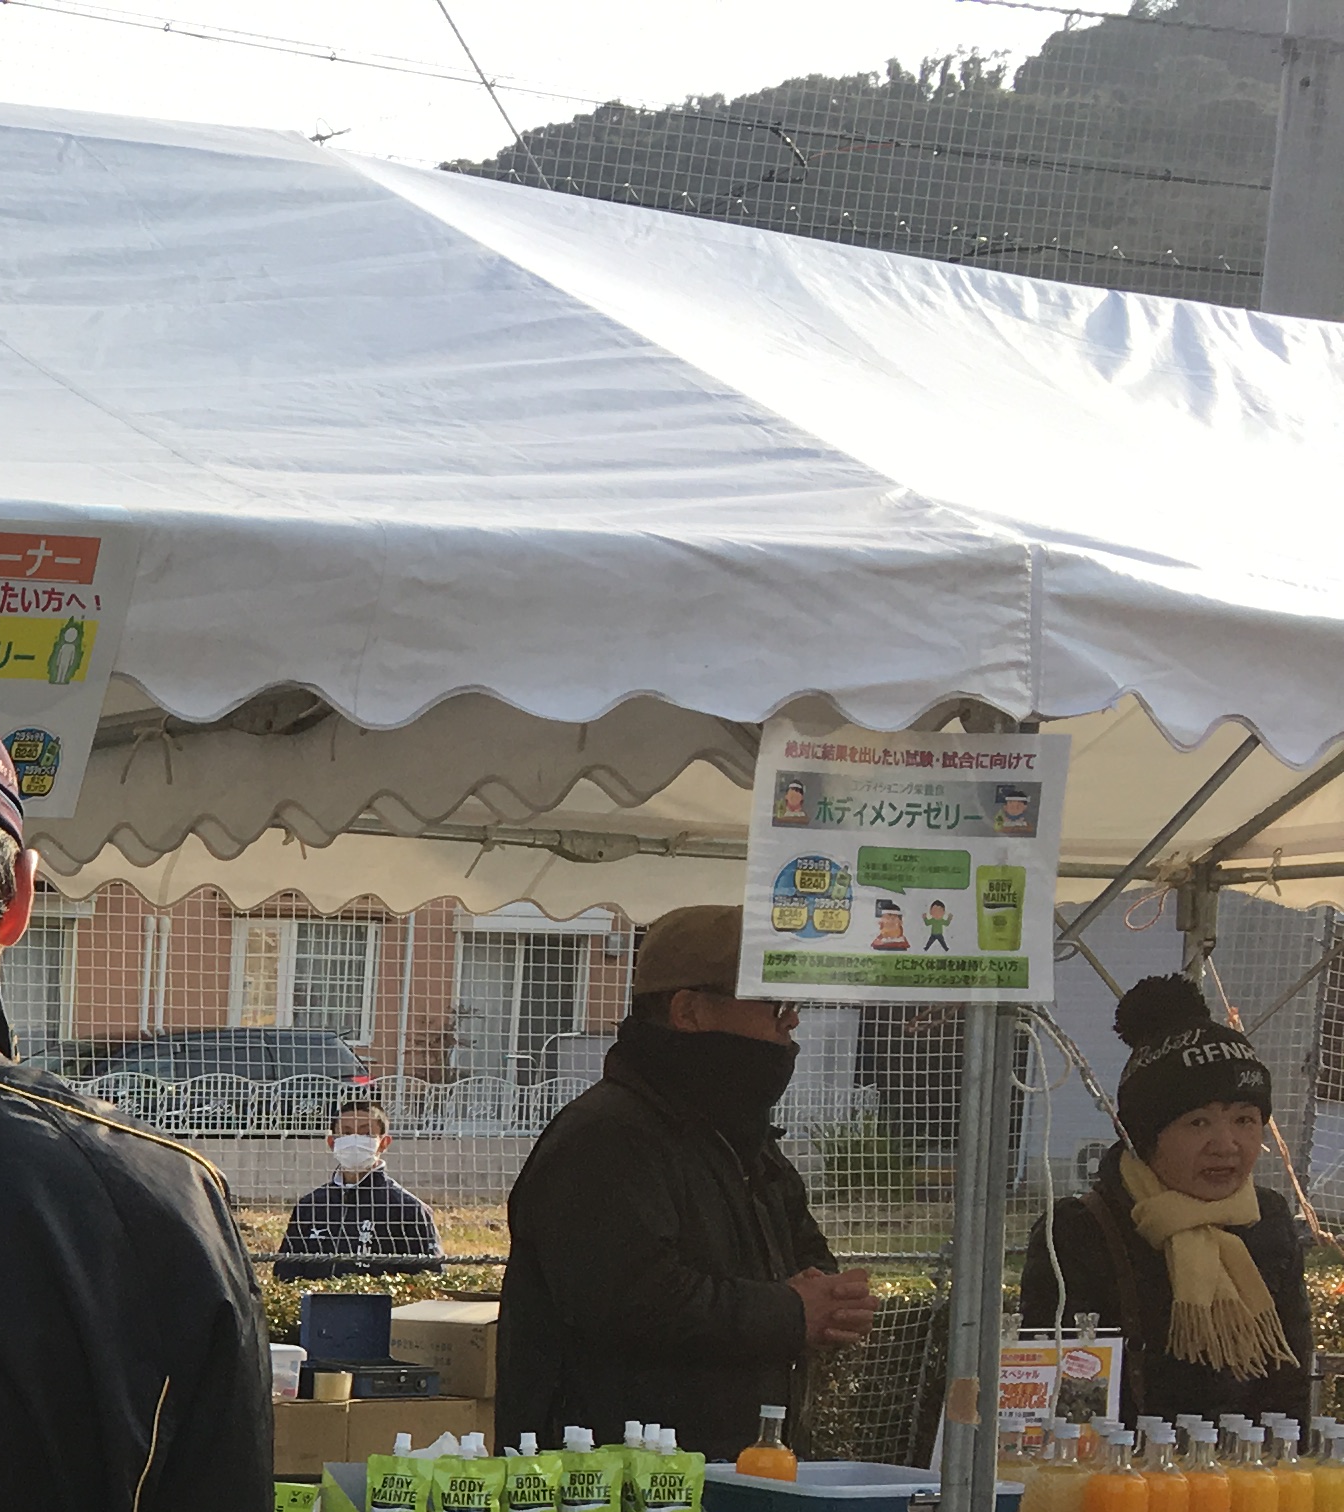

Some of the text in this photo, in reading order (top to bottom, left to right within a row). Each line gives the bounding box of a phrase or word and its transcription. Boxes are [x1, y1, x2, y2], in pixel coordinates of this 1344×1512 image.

[814, 797, 984, 830] ボディメンテゼリー
[381, 1476, 413, 1490] BODY
[449, 1479, 486, 1493] BODY
[515, 1477, 547, 1489] BODY
[570, 1473, 603, 1486] BODY
[651, 1475, 685, 1488] BODY
